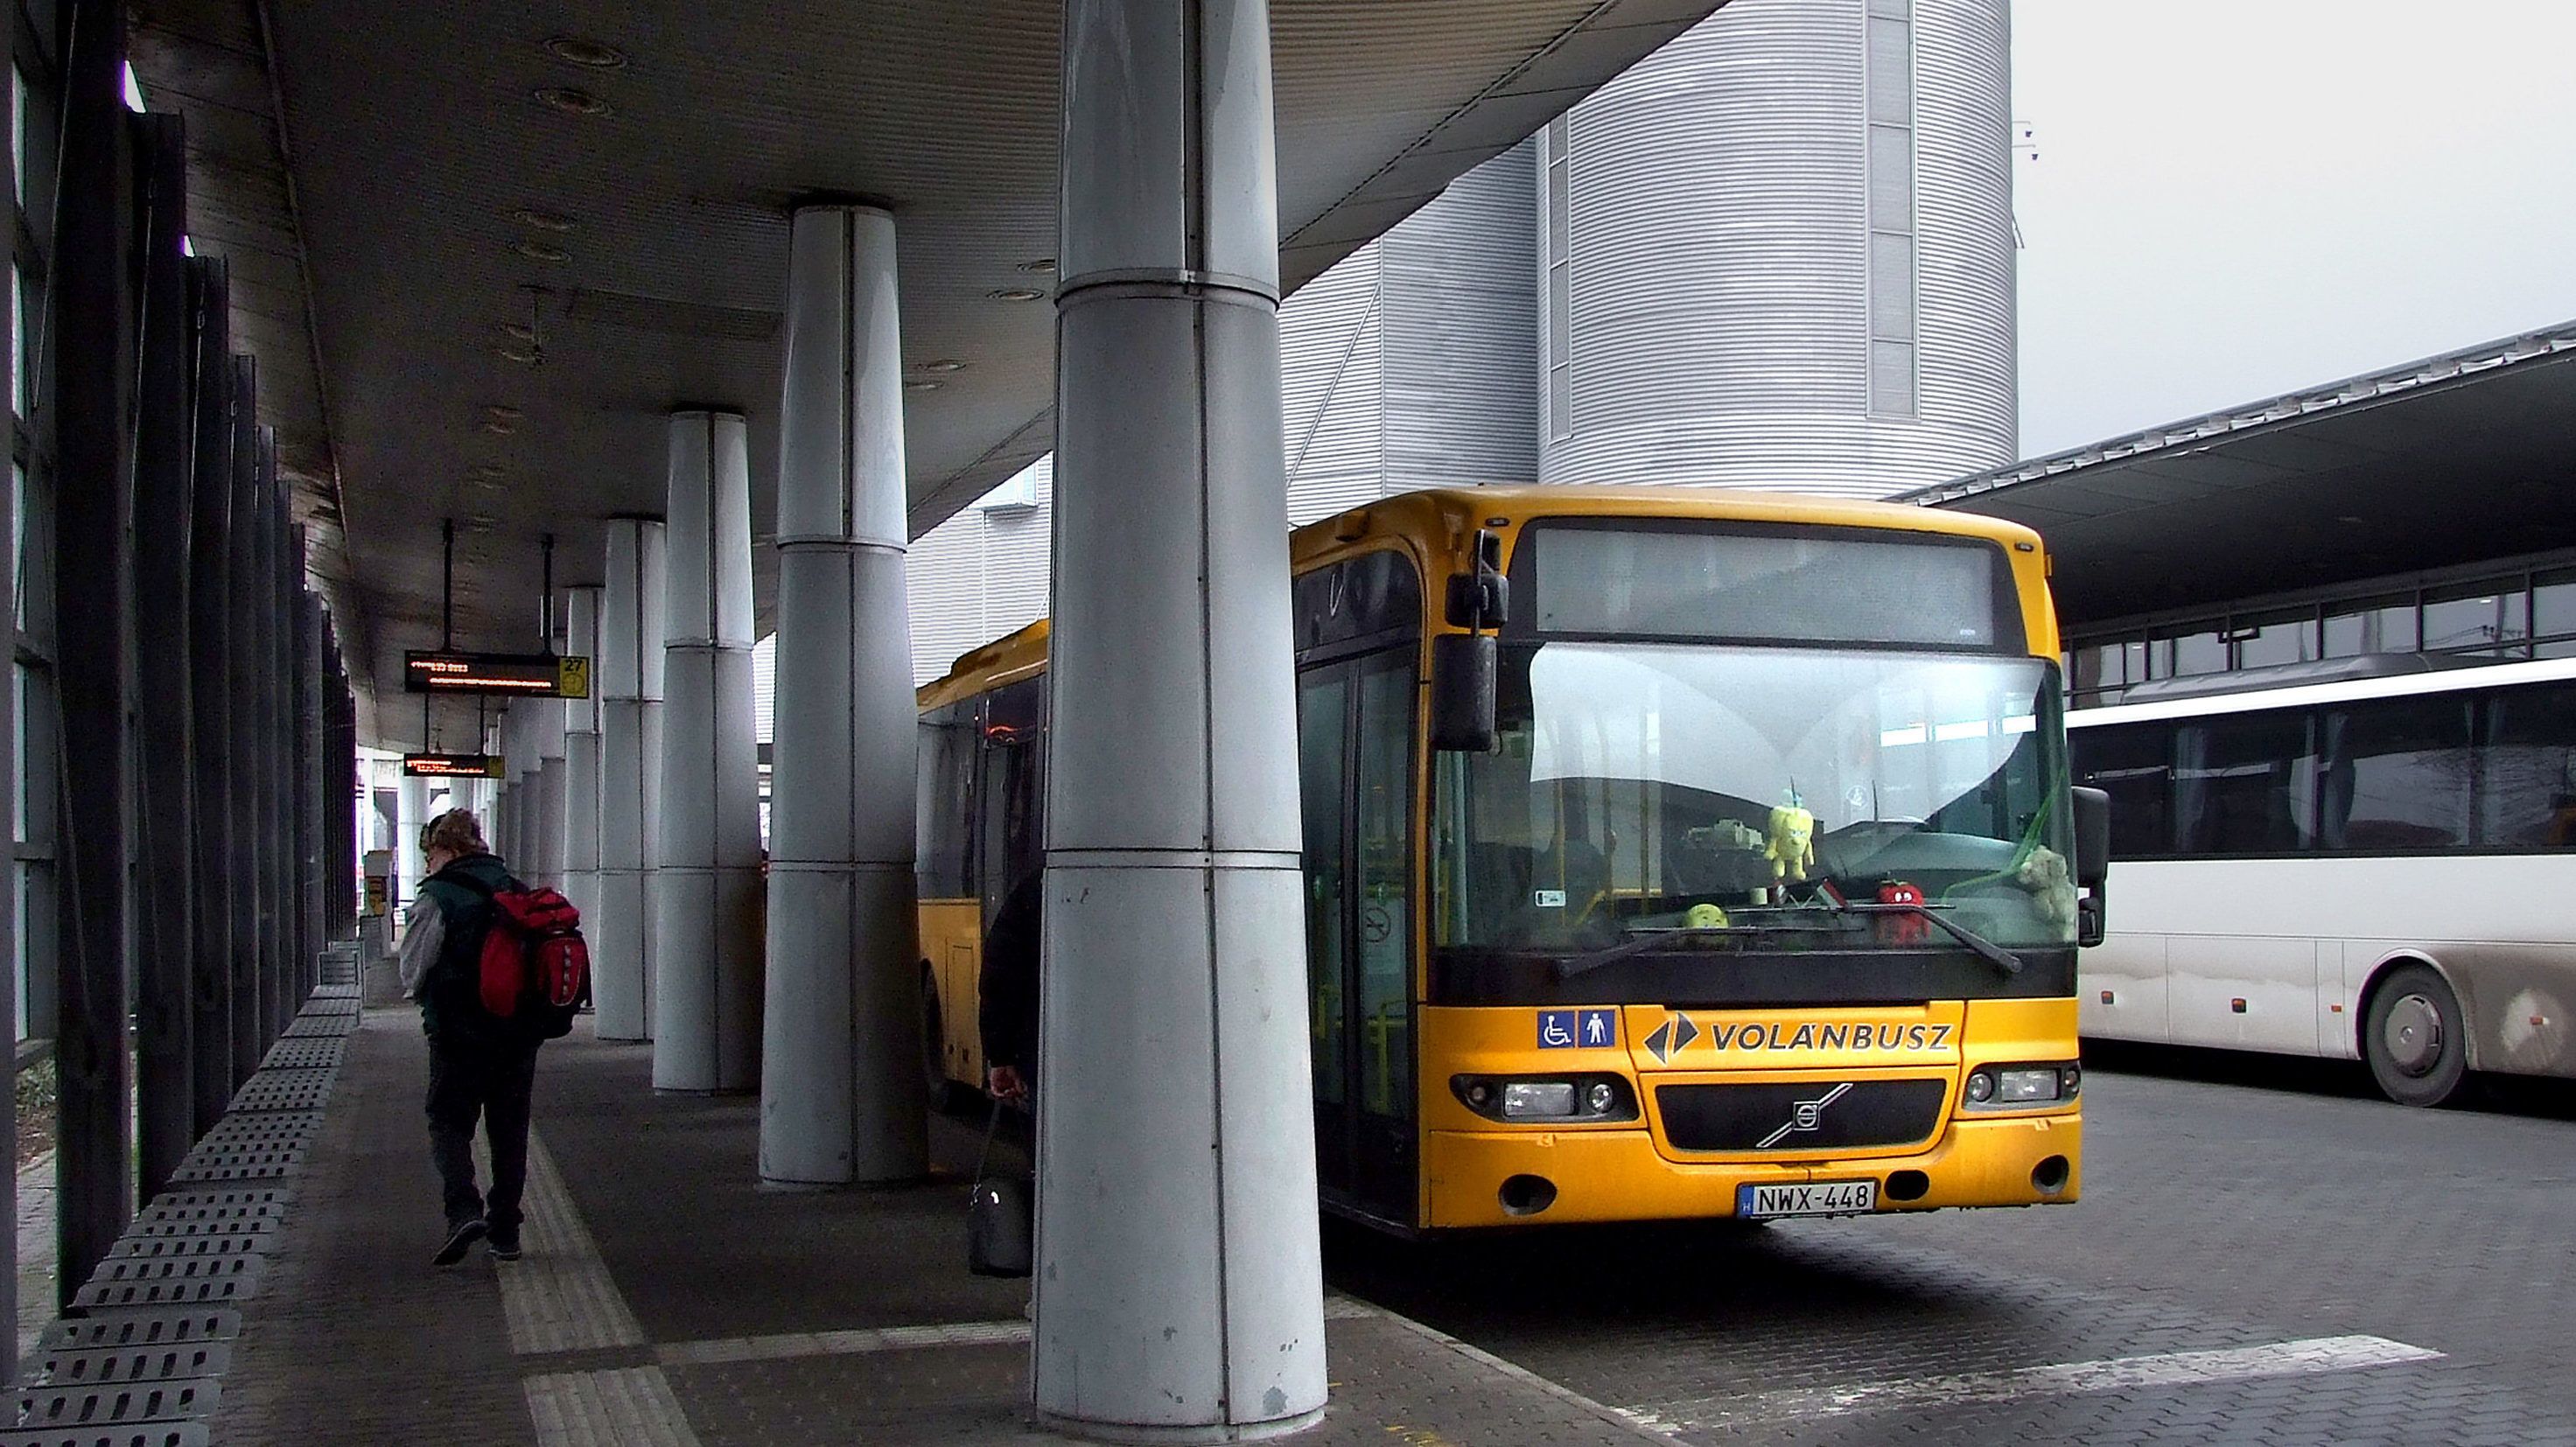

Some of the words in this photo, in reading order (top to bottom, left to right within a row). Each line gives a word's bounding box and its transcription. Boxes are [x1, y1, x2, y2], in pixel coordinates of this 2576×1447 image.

[564, 658, 583, 672] 27
[1711, 1023, 1952, 1052] VOLÁNBUSZ
[1758, 1185, 1869, 1213] NWX-448
